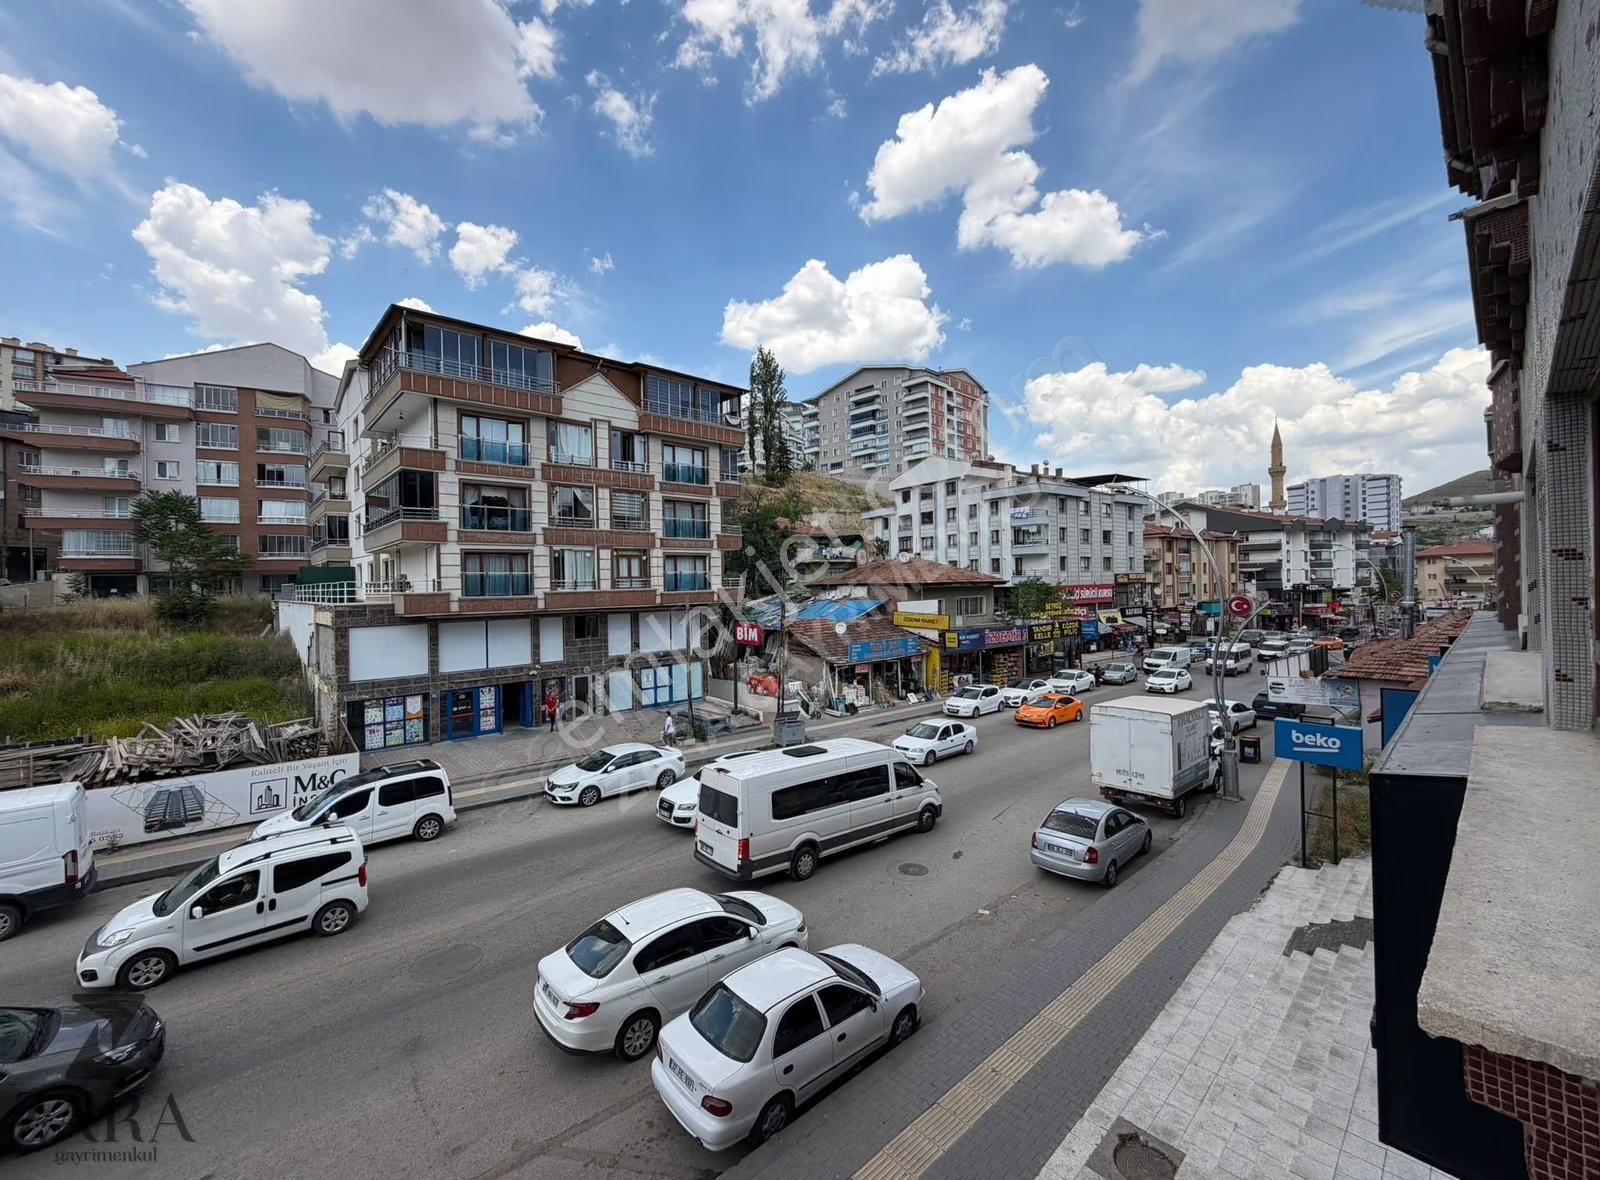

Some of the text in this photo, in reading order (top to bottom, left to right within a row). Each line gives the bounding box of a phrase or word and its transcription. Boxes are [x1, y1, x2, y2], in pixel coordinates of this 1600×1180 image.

[736, 624, 758, 642] BİM
[1291, 729, 1341, 748] beko
[250, 764, 284, 777] Kaliteli
[286, 764, 300, 773] Bir
[293, 768, 346, 795] M&C
